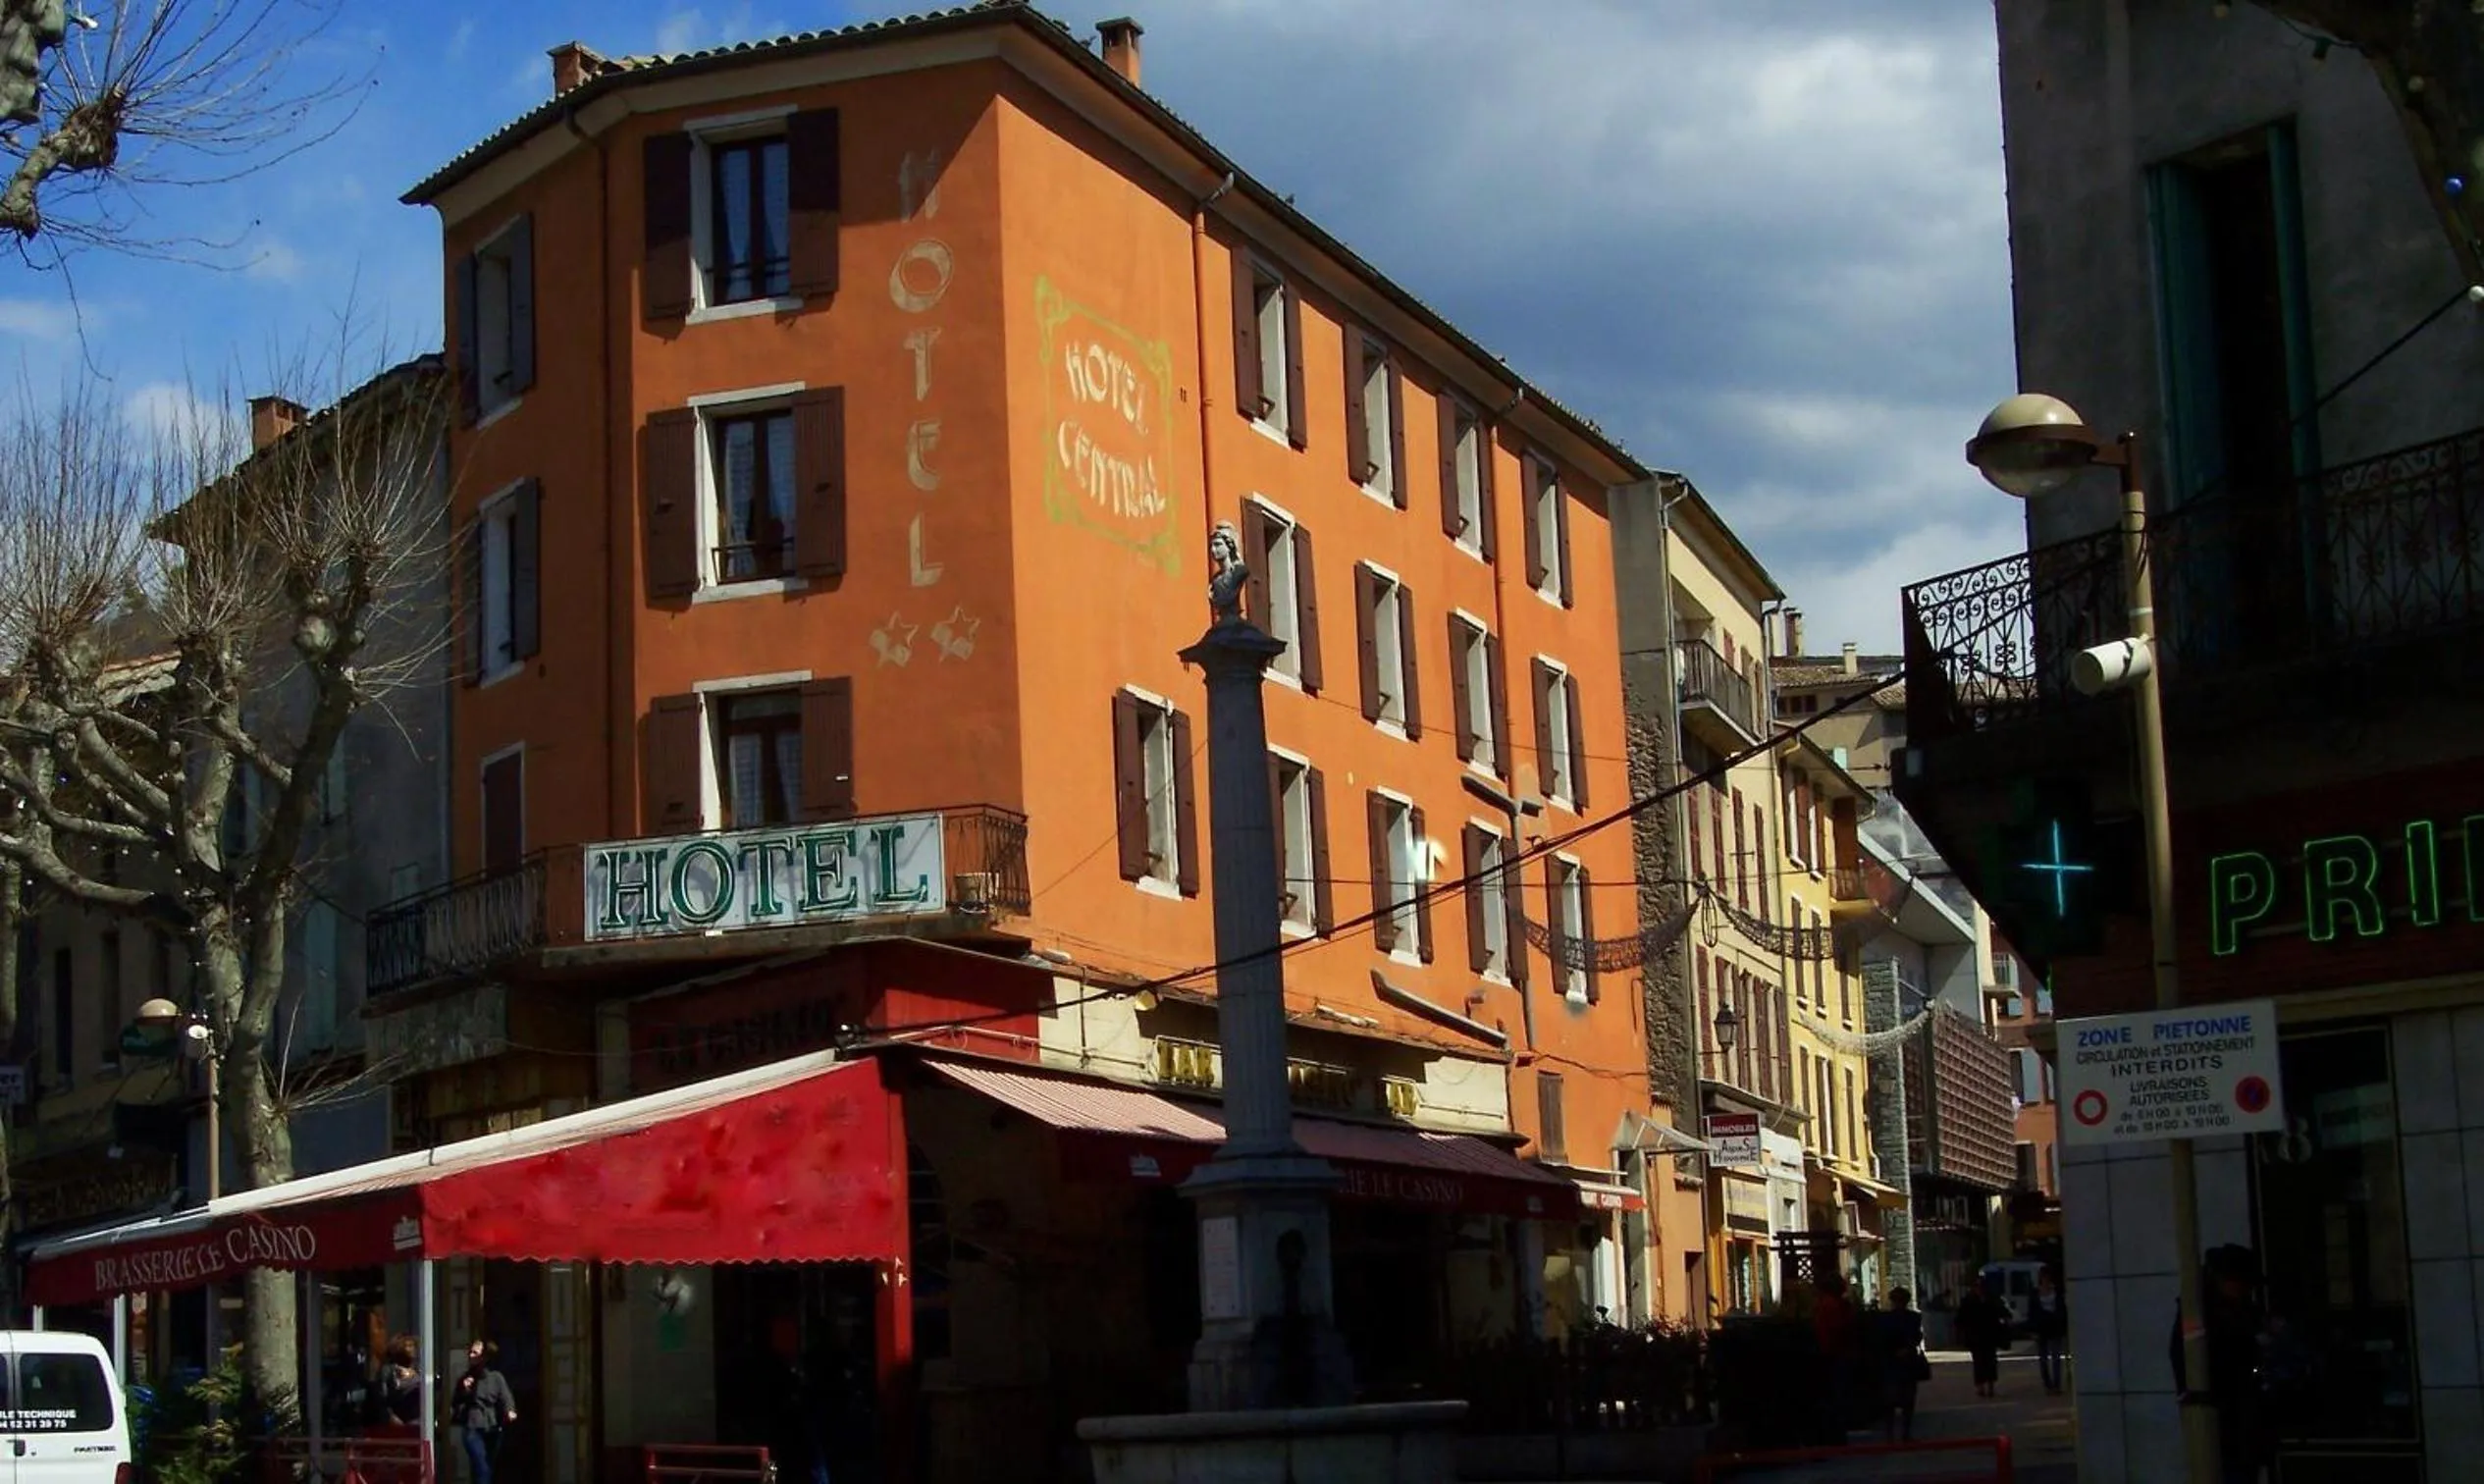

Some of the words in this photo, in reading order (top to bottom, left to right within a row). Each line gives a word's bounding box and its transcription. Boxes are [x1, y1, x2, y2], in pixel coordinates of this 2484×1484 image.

[889, 148, 954, 589] HOTEL
[1066, 341, 1148, 436] HOTEL
[1058, 416, 1166, 517] CENTRAL
[597, 825, 929, 929] HOTEL
[2076, 1046, 2148, 1065] CIRCULATION
[2163, 1036, 2254, 1059] STATIONNEMENT
[2078, 1027, 2132, 1047] ZONE
[2153, 1015, 2252, 1040] PIETONNE
[2110, 1055, 2223, 1078] INTERDITS
[2130, 1076, 2208, 1093] LIVRAISONS
[95, 1246, 196, 1292] BRASSERIE
[196, 1244, 227, 1275] LE
[225, 1225, 317, 1264] CASINO
[17, 1409, 77, 1418] TECHNIQUE
